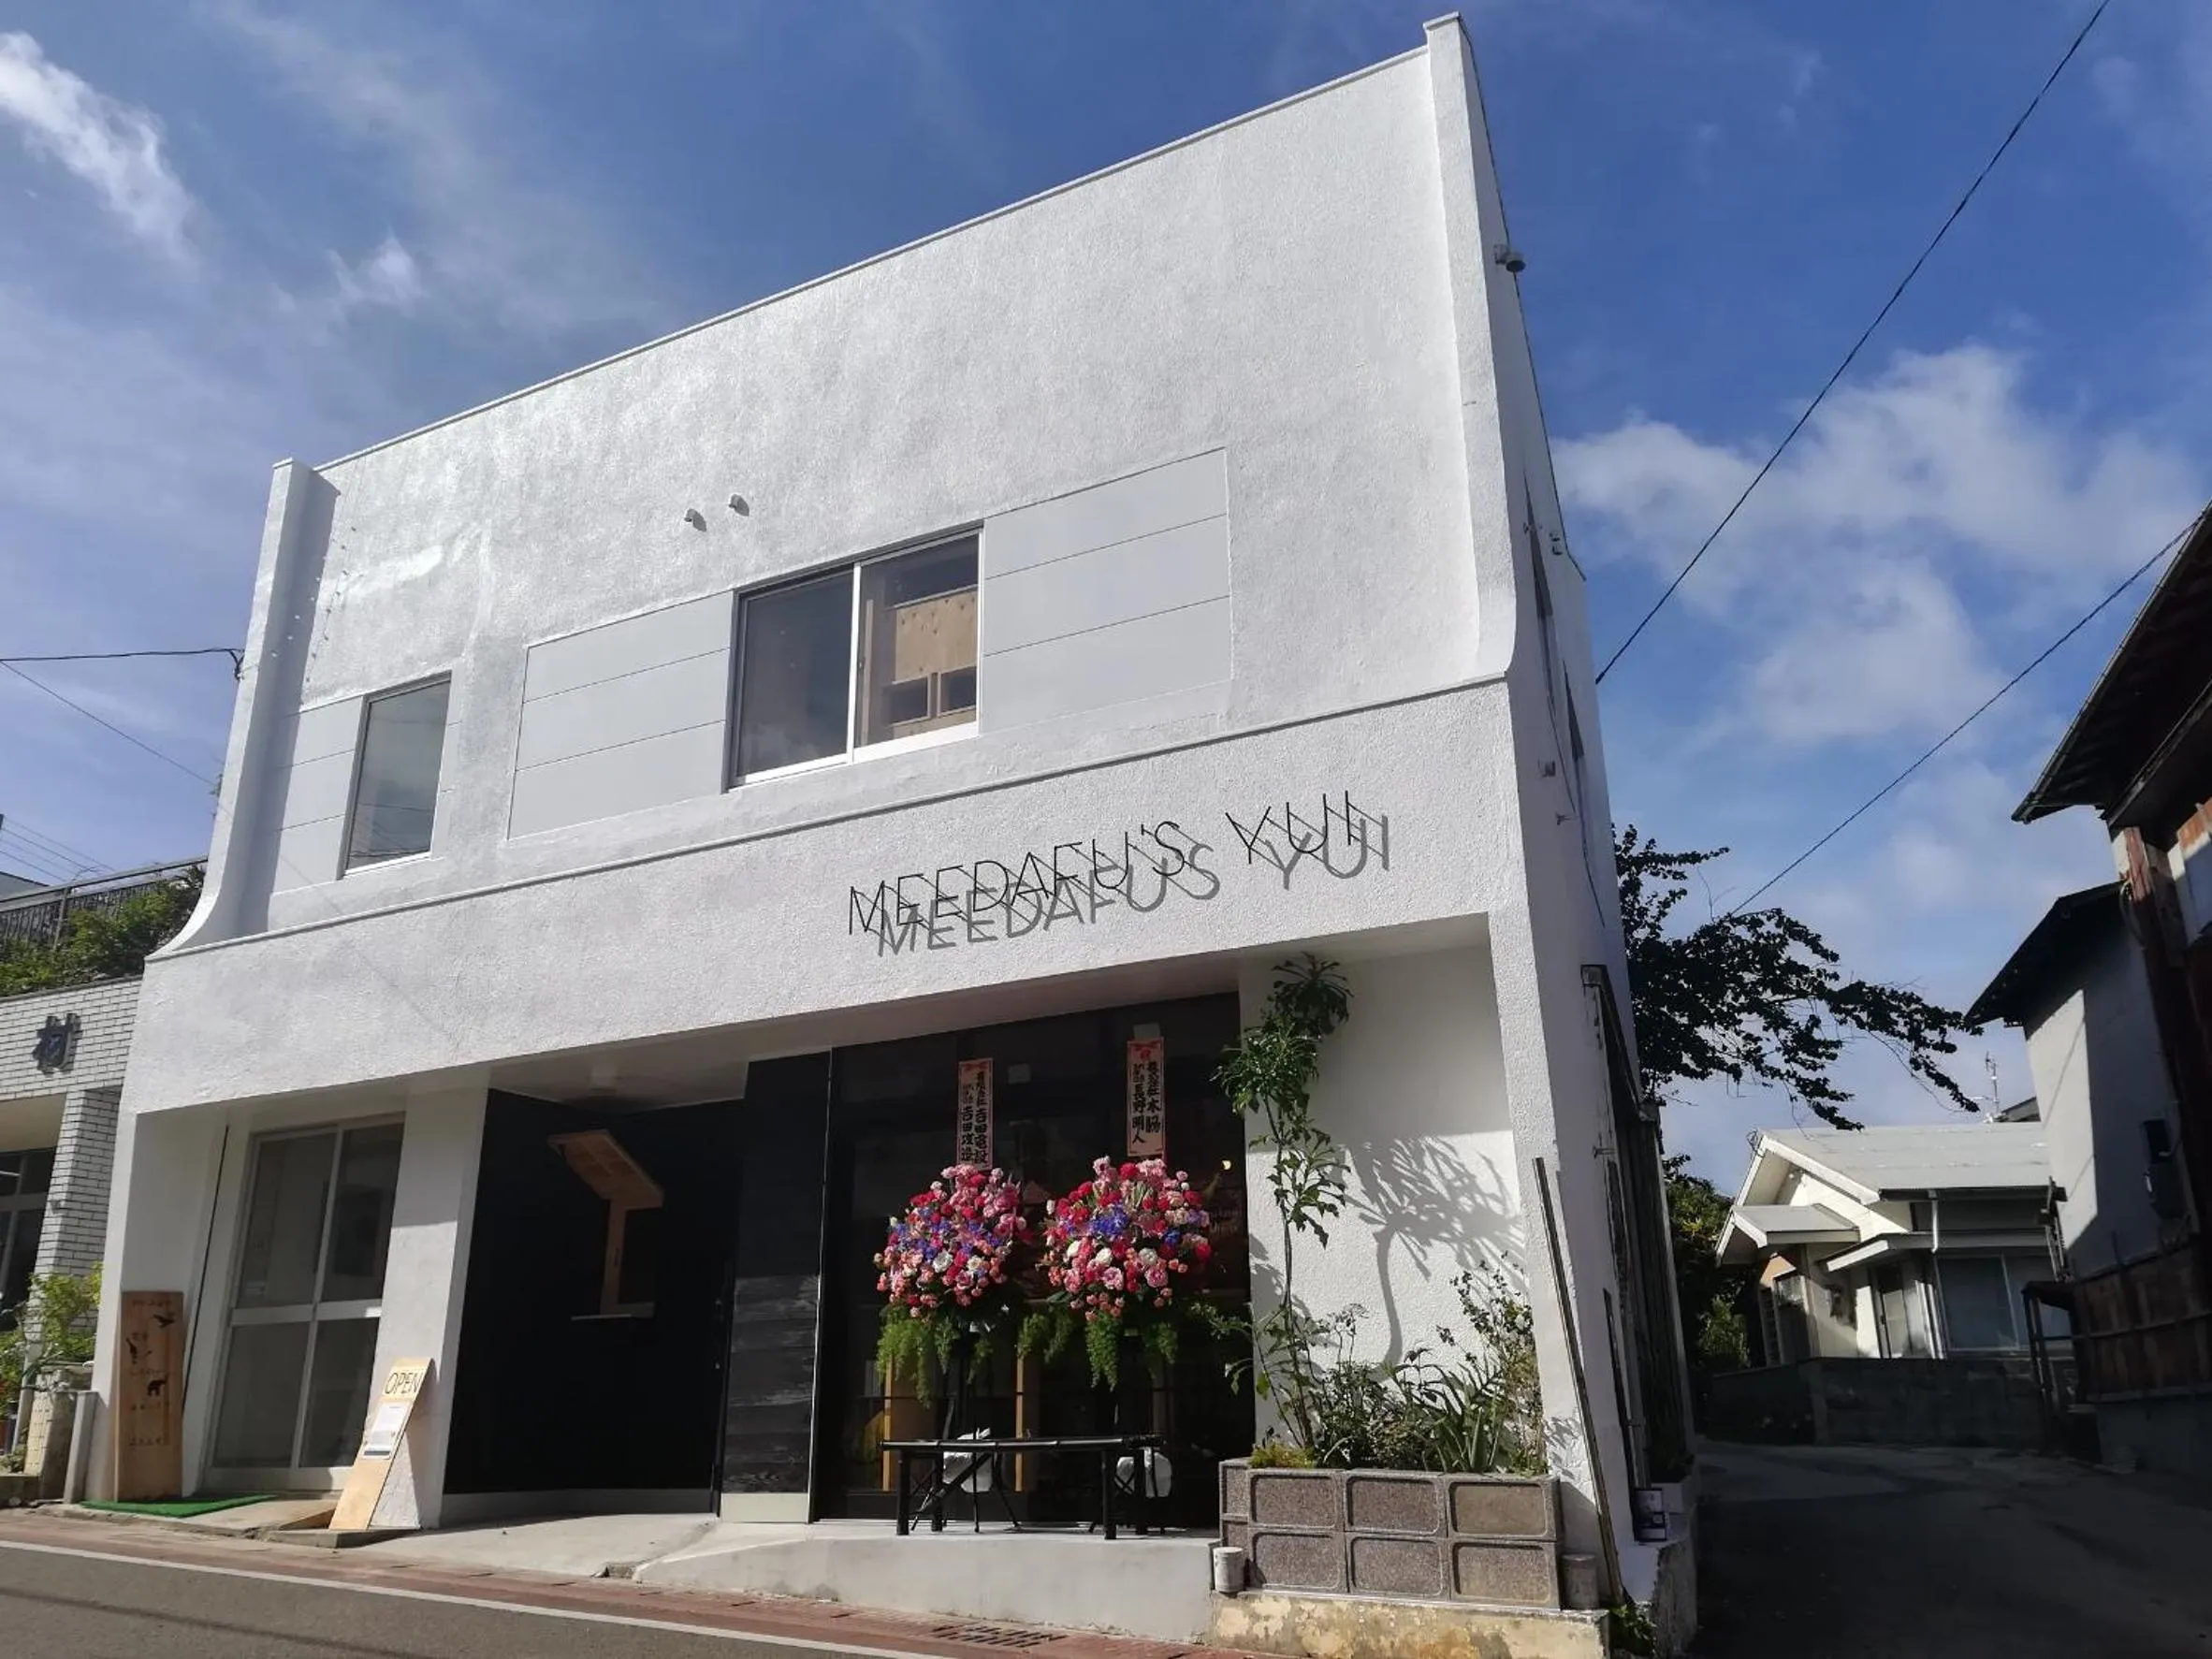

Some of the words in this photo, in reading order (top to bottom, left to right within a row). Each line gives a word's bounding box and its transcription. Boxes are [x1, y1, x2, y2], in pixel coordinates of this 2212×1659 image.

[849, 821, 1185, 936] MEEDAFU'S
[1225, 790, 1351, 865] YUI
[385, 1371, 424, 1395] OPEN
